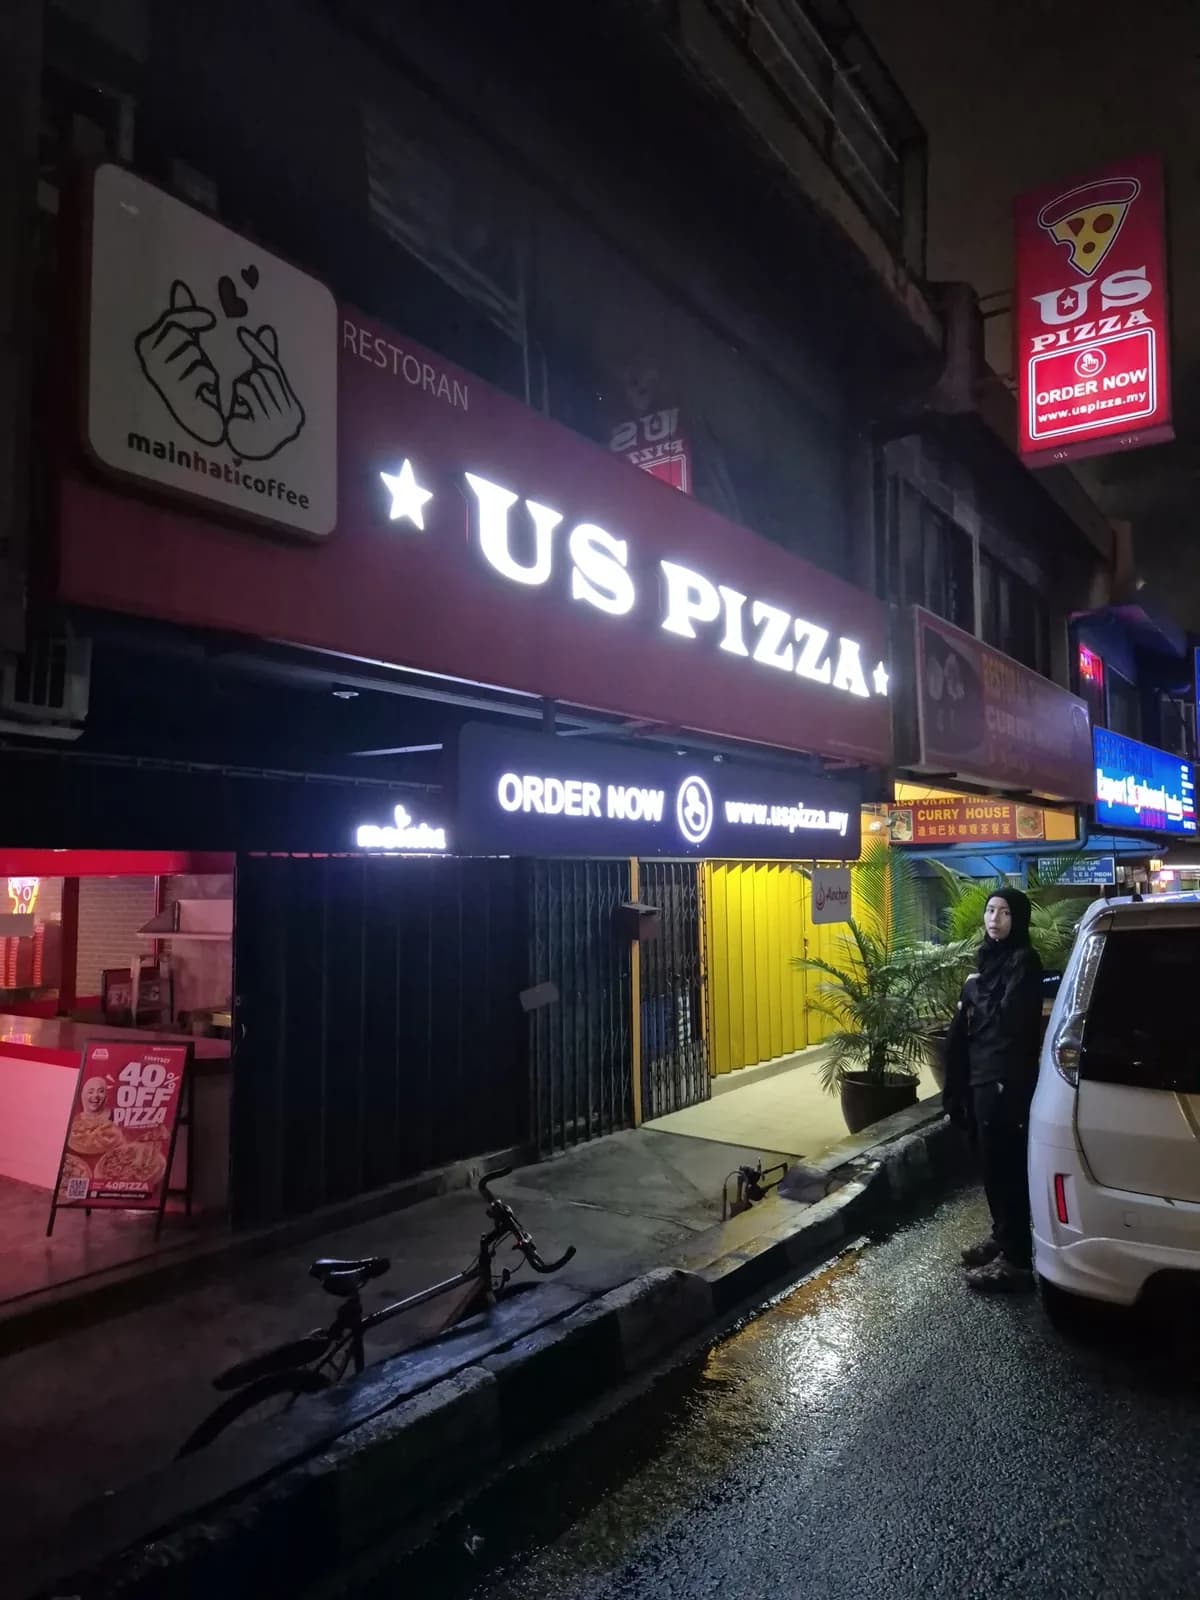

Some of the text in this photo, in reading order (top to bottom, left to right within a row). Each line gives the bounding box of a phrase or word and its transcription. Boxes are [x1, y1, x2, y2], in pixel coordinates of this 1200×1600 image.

[1032, 265, 1152, 325] US
[1031, 309, 1152, 353] PIZZA
[343, 320, 469, 411] RESTORAN
[1036, 368, 1147, 406] ORDER NOW
[1038, 392, 1147, 423] www.uspizza.my
[127, 432, 310, 509] mainhaticoffee
[465, 471, 871, 698] US PIZZA
[498, 773, 850, 837] ORDER NOW www.uspizza.my
[917, 806, 1011, 821] CURRY HOUSE
[113, 1107, 168, 1128] PIZZA
[117, 1086, 176, 1108] OFF
